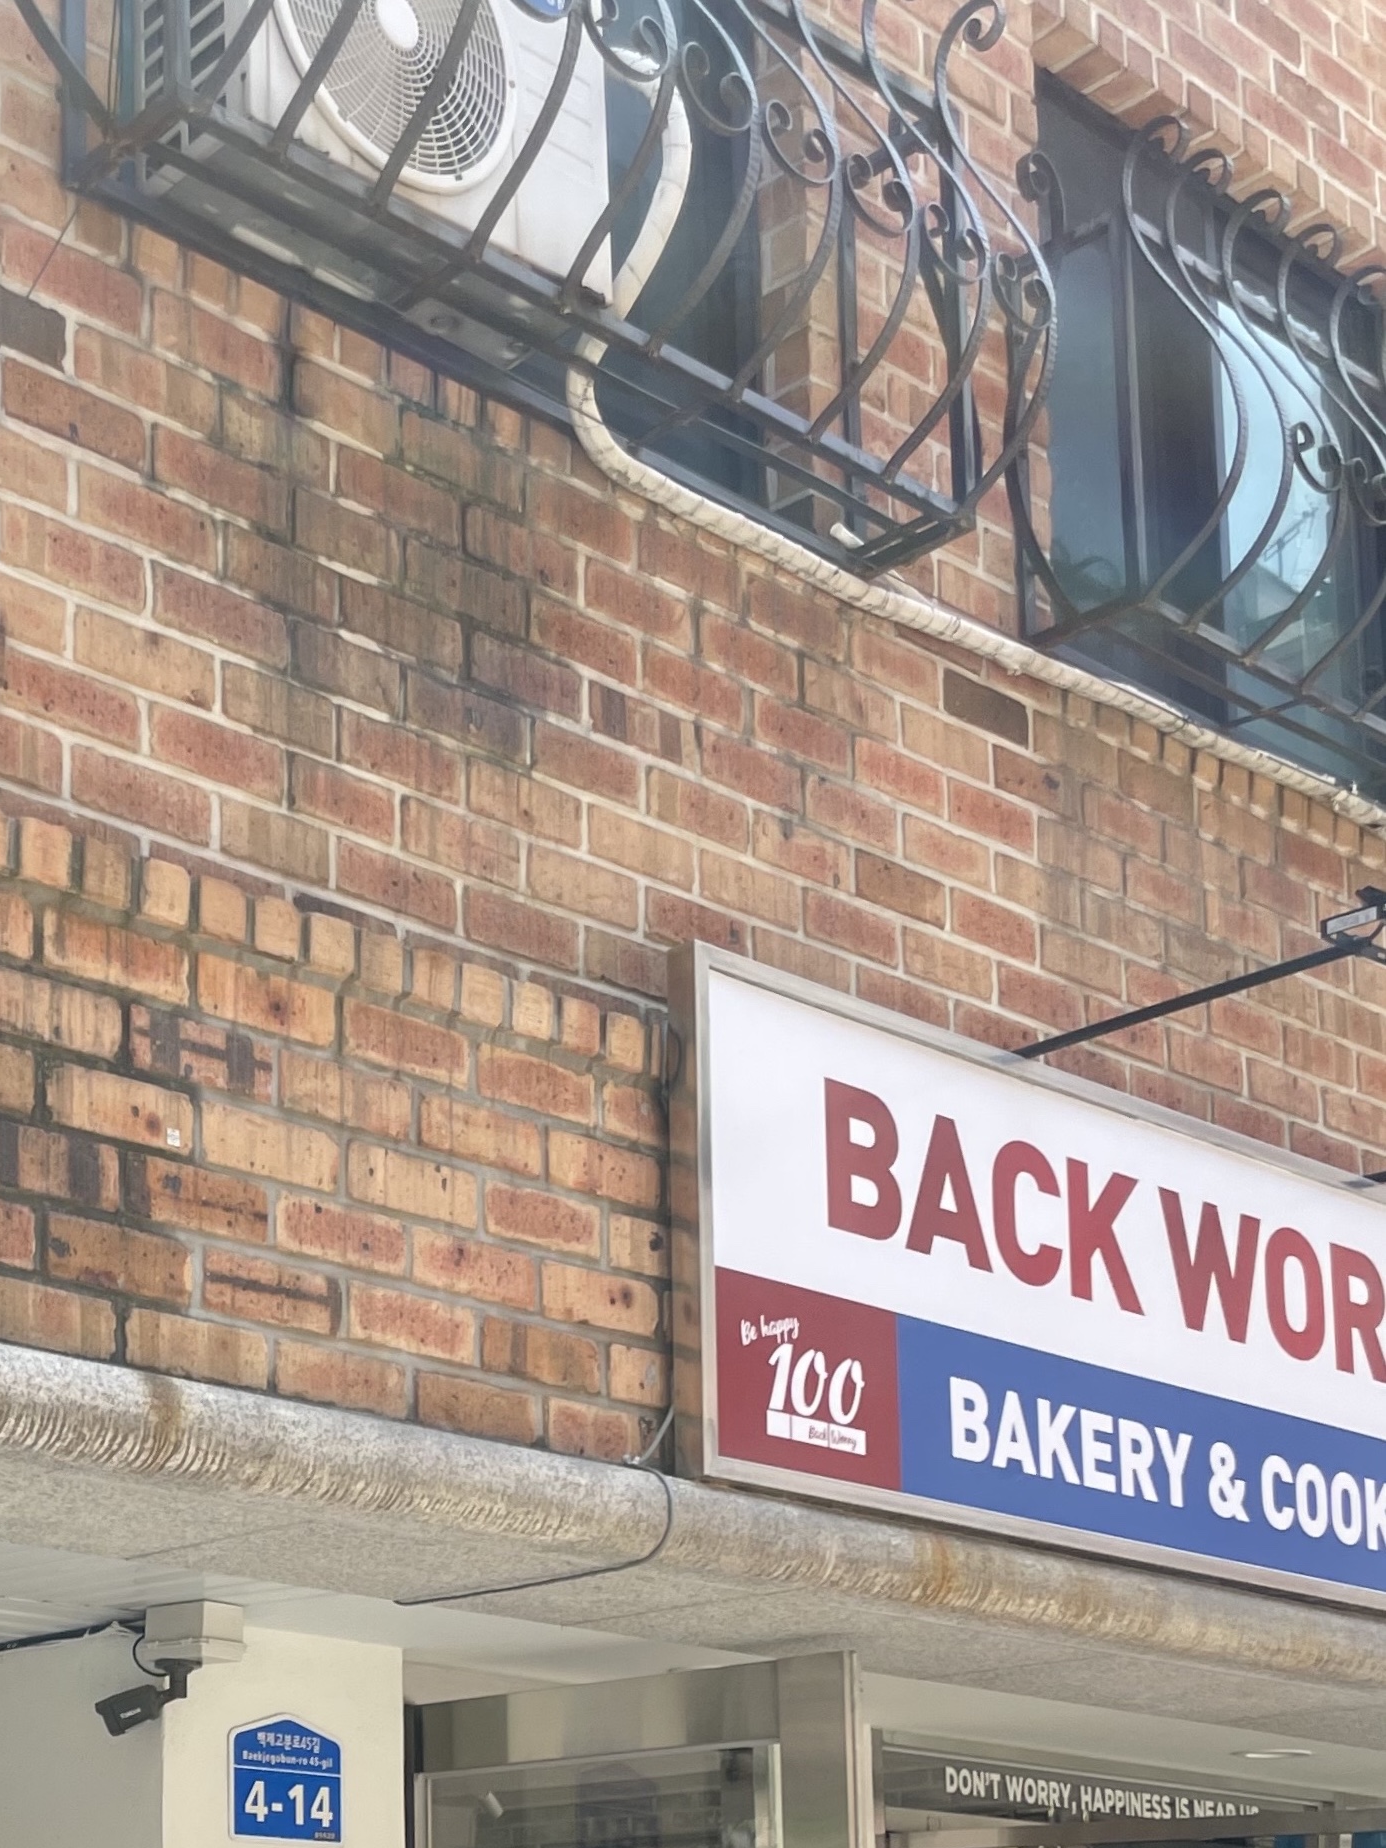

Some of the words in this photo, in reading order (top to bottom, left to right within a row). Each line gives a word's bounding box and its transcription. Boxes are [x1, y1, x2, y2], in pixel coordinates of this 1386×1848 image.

[824, 1077, 1145, 1317] BACK
[1157, 1186, 1386, 1384] WOR
[740, 1319, 758, 1346] Be
[760, 1314, 800, 1344] happy
[767, 1343, 866, 1425] 100
[949, 1376, 1194, 1508] BAKERY
[1209, 1441, 1251, 1523] &
[242, 1750, 308, 1766] Baekjegobun-ro
[309, 1756, 333, 1770] 45-gil
[257, 1731, 321, 1754] 백제고분로45길
[244, 1780, 334, 1828] 4-14
[945, 1765, 1001, 1800] DON'T
[1005, 1774, 1077, 1815] WORRY,
[1080, 1784, 1172, 1820] HAPPINESS
[1175, 1796, 1191, 1819] IS
